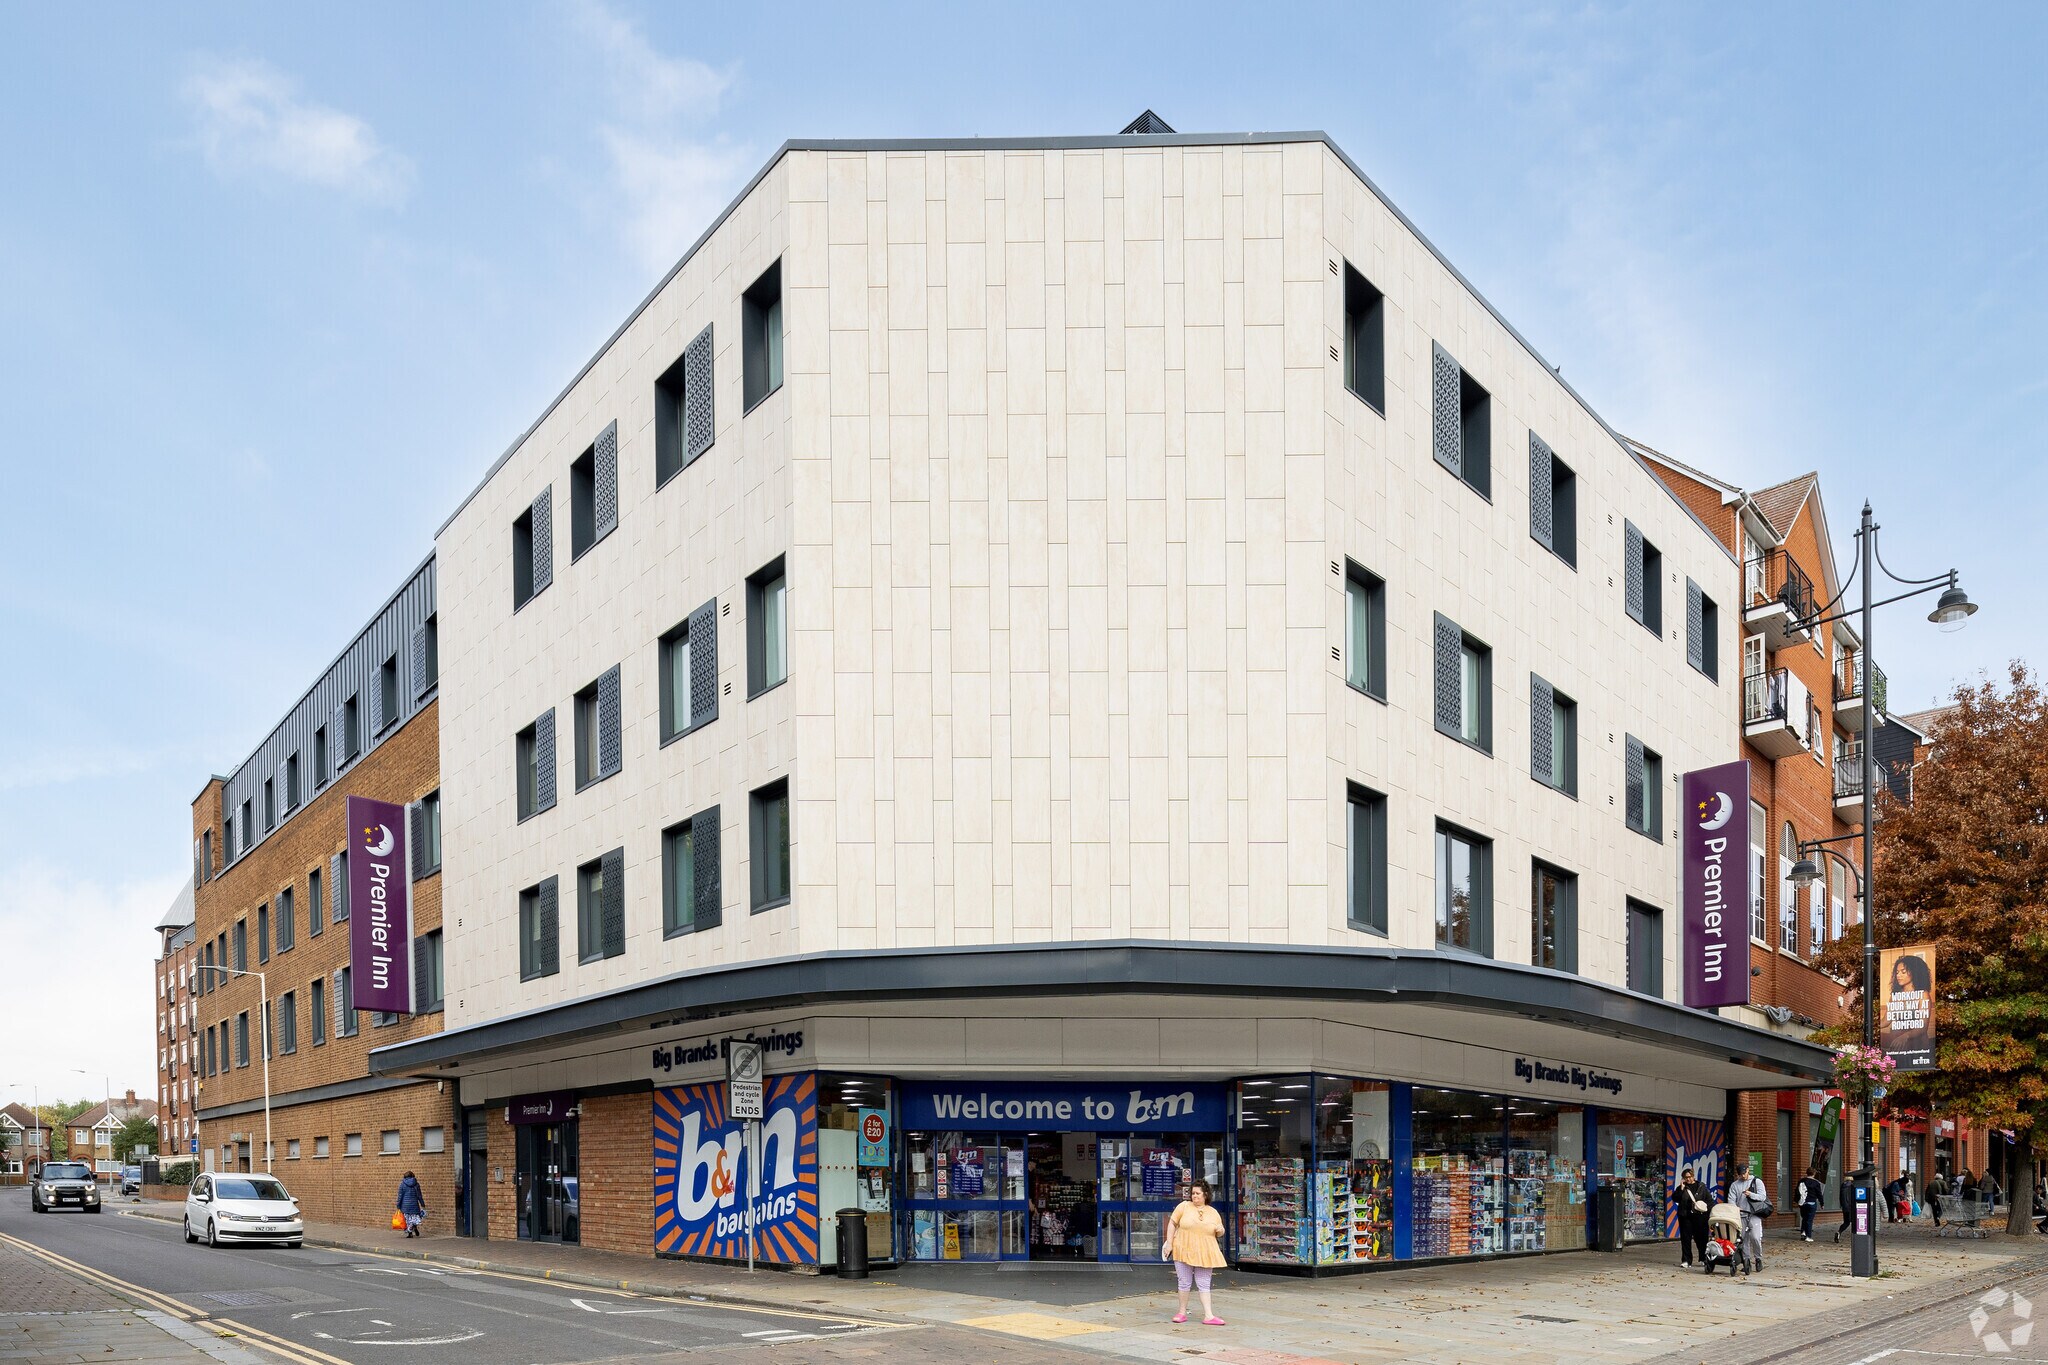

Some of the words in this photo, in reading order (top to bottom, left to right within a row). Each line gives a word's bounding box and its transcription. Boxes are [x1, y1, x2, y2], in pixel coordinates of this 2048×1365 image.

[1704, 837, 1727, 938] Premier
[370, 863, 392, 952] Premier
[1704, 943, 1727, 982] Inn
[372, 955, 393, 989] Inn
[1891, 989, 1924, 1001] WORKOUT
[1886, 1001, 1905, 1011] YOUR
[1906, 1000, 1919, 1010] WAY
[1921, 999, 1929, 1009] AT
[1886, 1011, 1913, 1021] BETTER
[1914, 1009, 1929, 1019] GYM
[1891, 1019, 1924, 1030] ROMFORD
[653, 1046, 672, 1072] Big
[674, 1039, 718, 1065] Brands
[1515, 1057, 1533, 1083] Big
[1535, 1061, 1570, 1084] Brands
[1571, 1067, 1587, 1091] Big
[1588, 1071, 1622, 1095] Savings
[735, 1106, 760, 1115] ENDS
[933, 1092, 1072, 1119] Welcome
[1082, 1096, 1115, 1121] to
[1126, 1090, 1195, 1124] b&m
[867, 1119, 872, 1127] 2
[872, 1119, 881, 1127] for
[866, 1127, 882, 1138] £20
[863, 1145, 885, 1157] TOYS
[1857, 1188, 1865, 1198] P
